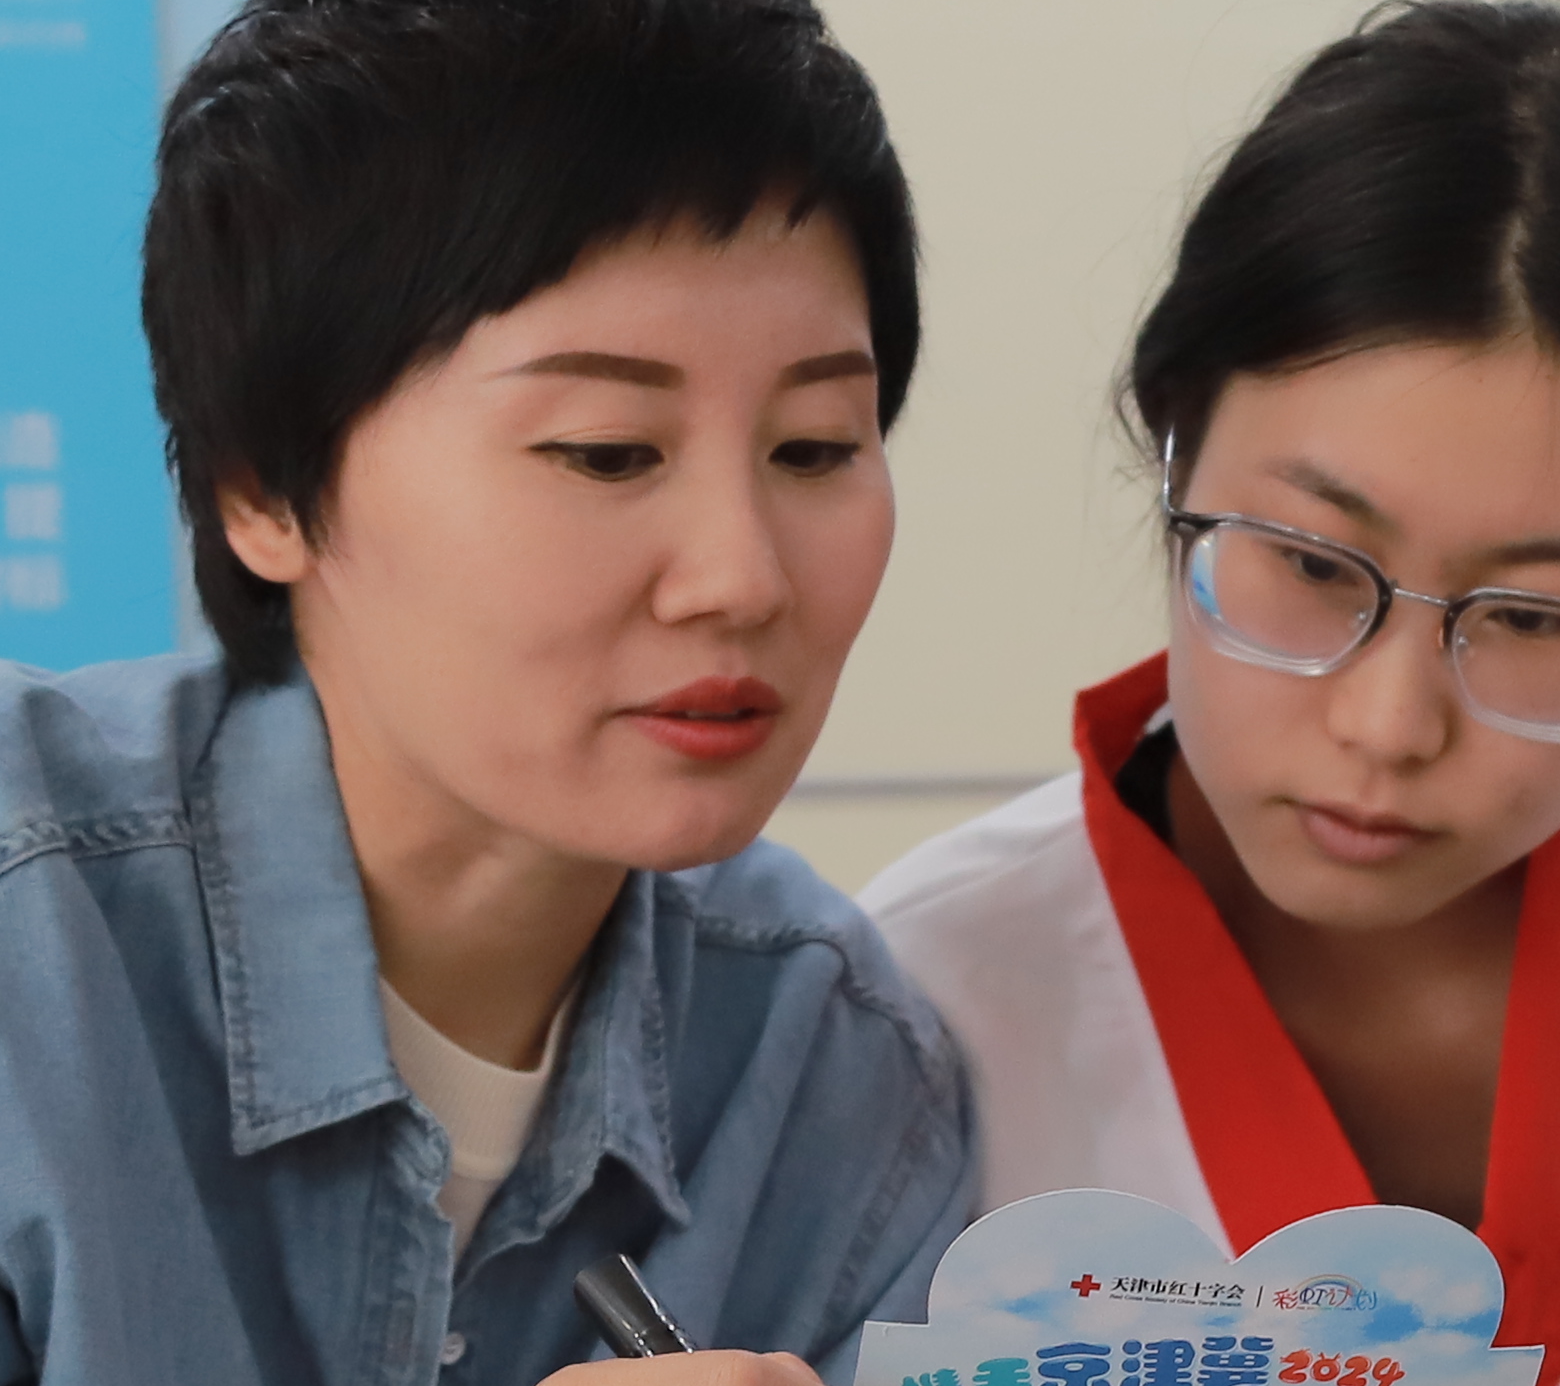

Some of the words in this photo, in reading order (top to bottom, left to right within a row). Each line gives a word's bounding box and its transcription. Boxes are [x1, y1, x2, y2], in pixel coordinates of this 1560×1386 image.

[1110, 1275, 1246, 1301] 天津市红十字会
